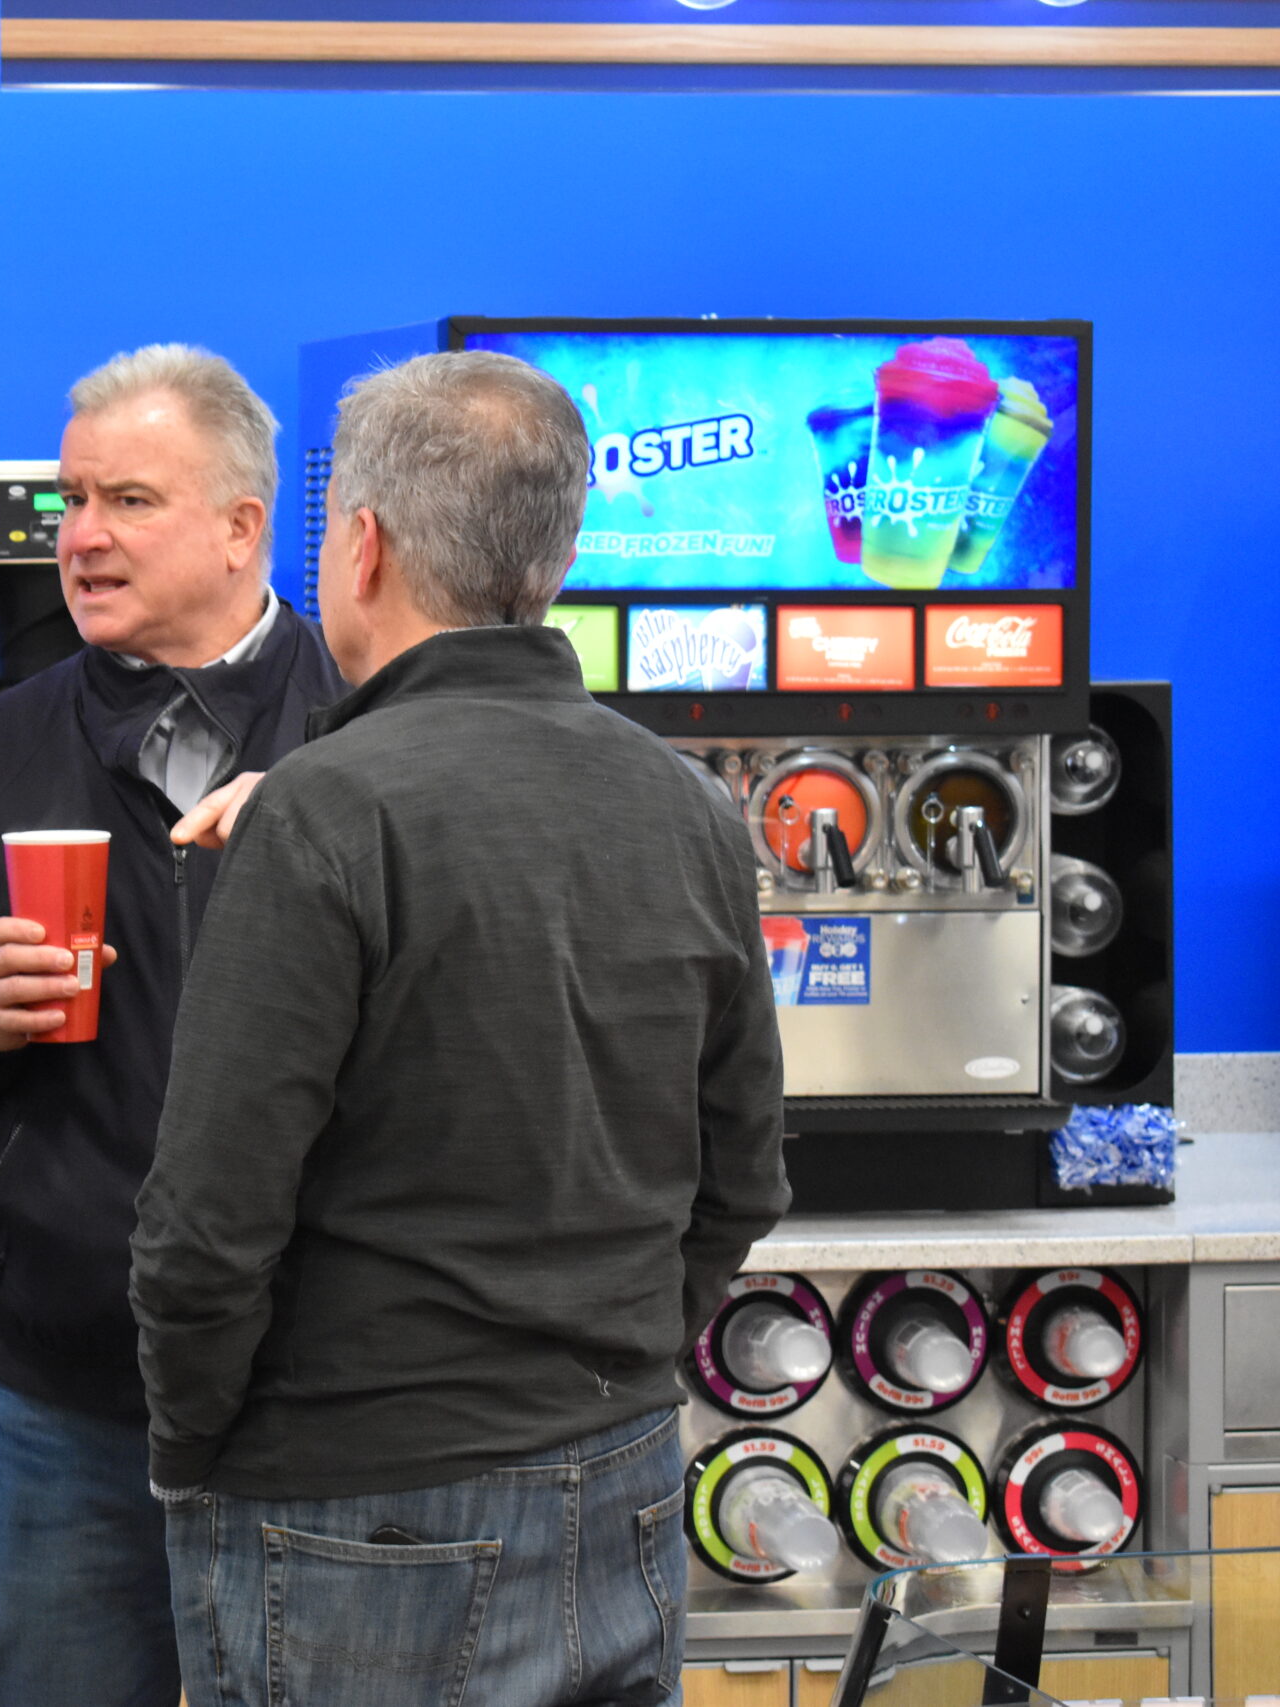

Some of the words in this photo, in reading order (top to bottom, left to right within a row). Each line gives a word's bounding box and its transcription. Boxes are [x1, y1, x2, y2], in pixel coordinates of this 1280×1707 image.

[624, 533, 718, 554] FROZEN
[639, 624, 741, 682] Raspberry
[809, 971, 865, 986] FREE
[855, 1291, 884, 1354] MEDIUM
[1009, 1315, 1025, 1370] SMALL
[1095, 1442, 1132, 1486] SMALL
[698, 1483, 711, 1538] LARGE
[854, 1466, 870, 1521] LARGE
